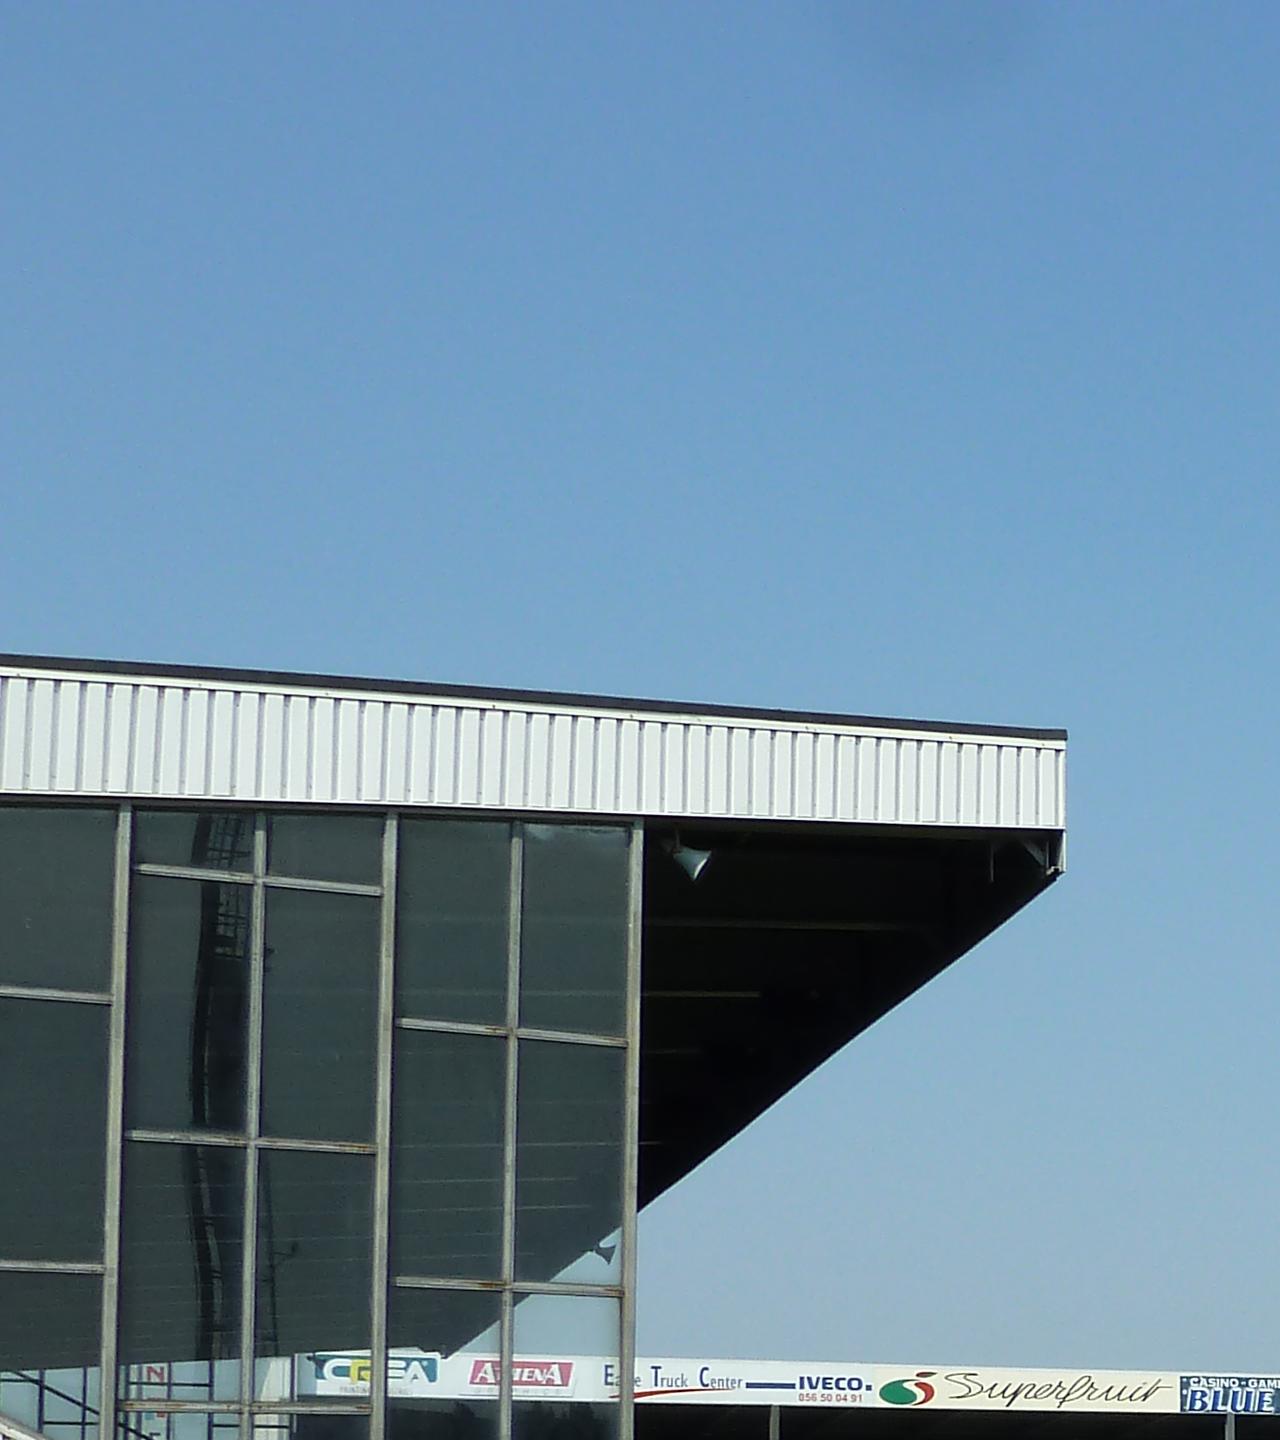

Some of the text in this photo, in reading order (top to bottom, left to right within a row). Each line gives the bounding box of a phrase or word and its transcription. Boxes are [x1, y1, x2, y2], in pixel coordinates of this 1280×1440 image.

[650, 1365, 688, 1388] Truck
[699, 1367, 743, 1390] Center
[799, 1376, 863, 1391] IVECO
[944, 1373, 1173, 1408] Superfruit
[1187, 1386, 1275, 1413] BLUE
